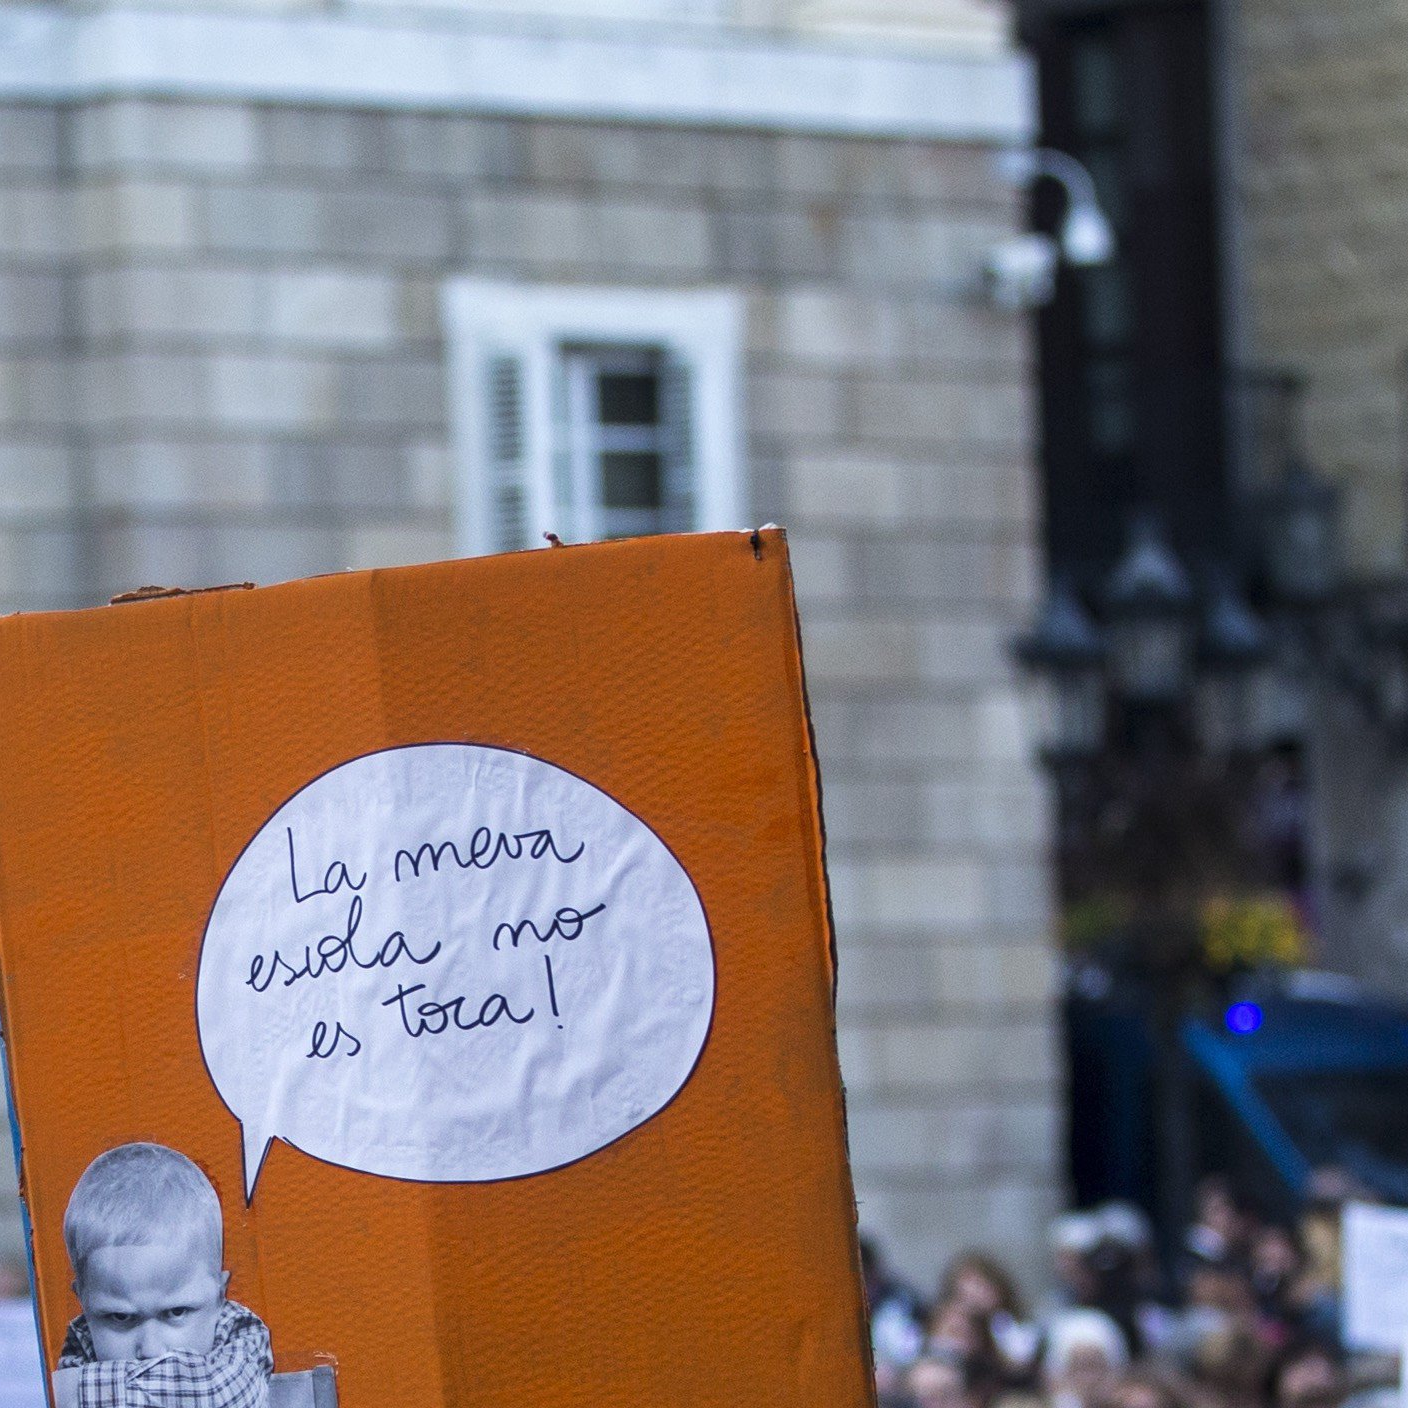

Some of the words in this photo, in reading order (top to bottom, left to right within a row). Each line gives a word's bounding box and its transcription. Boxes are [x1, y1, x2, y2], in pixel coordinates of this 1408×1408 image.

[286, 826, 367, 903] La
[393, 826, 586, 882] meva
[245, 894, 442, 993] escola
[492, 902, 607, 951] no
[306, 1020, 361, 1059] es
[381, 954, 565, 1038] toca!
